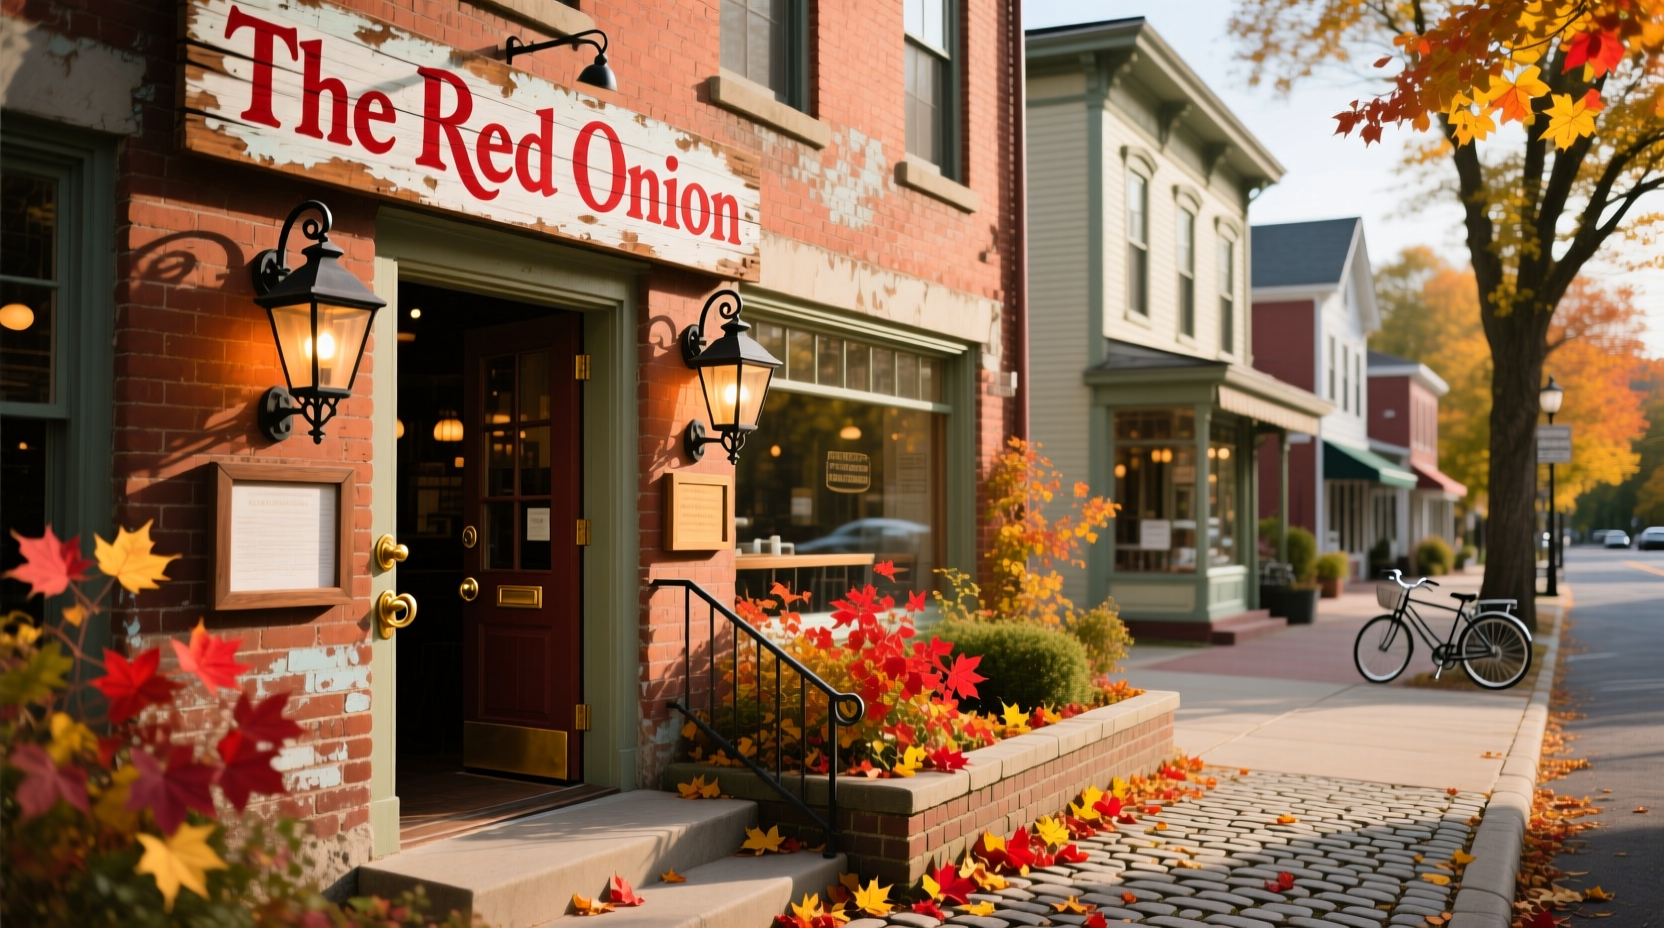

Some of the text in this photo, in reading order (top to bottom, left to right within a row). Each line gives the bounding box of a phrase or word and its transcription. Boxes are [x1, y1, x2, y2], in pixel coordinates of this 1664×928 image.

[224, 5, 741, 245] The Red Onion
